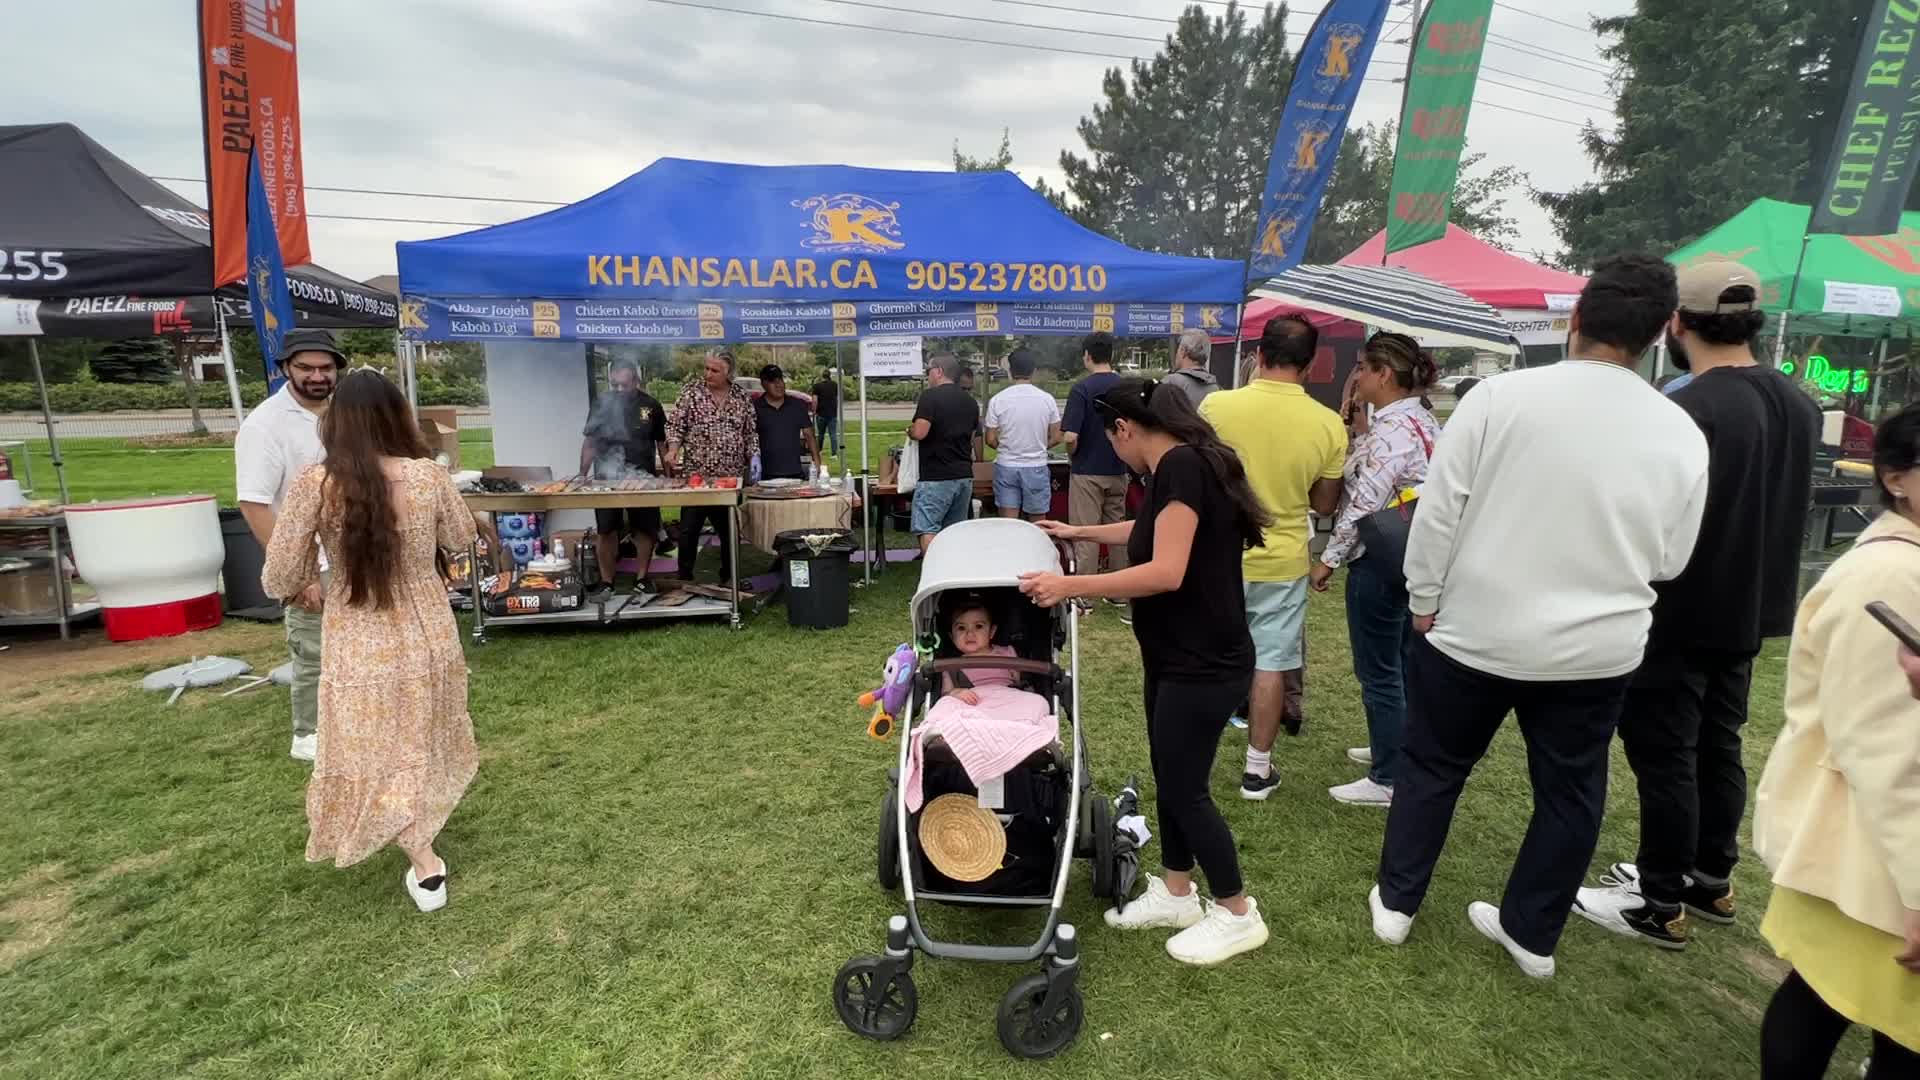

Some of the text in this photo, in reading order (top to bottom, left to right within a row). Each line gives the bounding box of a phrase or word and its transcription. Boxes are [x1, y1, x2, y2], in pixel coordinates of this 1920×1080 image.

[230, 43, 246, 69] FINE
[219, 70, 251, 153] PAEEZ
[1829, 102, 1888, 216] CHEF
[588, 255, 1107, 292] KHANSALAR.CA 9052378010
[65, 296, 176, 315] PAEEZ FINE FOODS
[343, 290, 365, 314] (905)
[364, 298, 397, 319] 898-2255
[491, 305, 529, 318] Joojeh
[575, 305, 620, 316] Chicken
[623, 305, 659, 316] Kabob
[869, 303, 917, 314] Ghormeh
[919, 302, 946, 313] Sabzi
[451, 321, 491, 333] Kabob
[494, 322, 518, 336] Digi
[576, 323, 622, 335] Chicken
[624, 324, 661, 335] Kabob
[662, 324, 684, 337] (leg)
[742, 323, 768, 336] Barg
[770, 323, 806, 334] Kabob
[917, 318, 973, 330] Bademjoon
[1043, 317, 1091, 329] Bademjan
